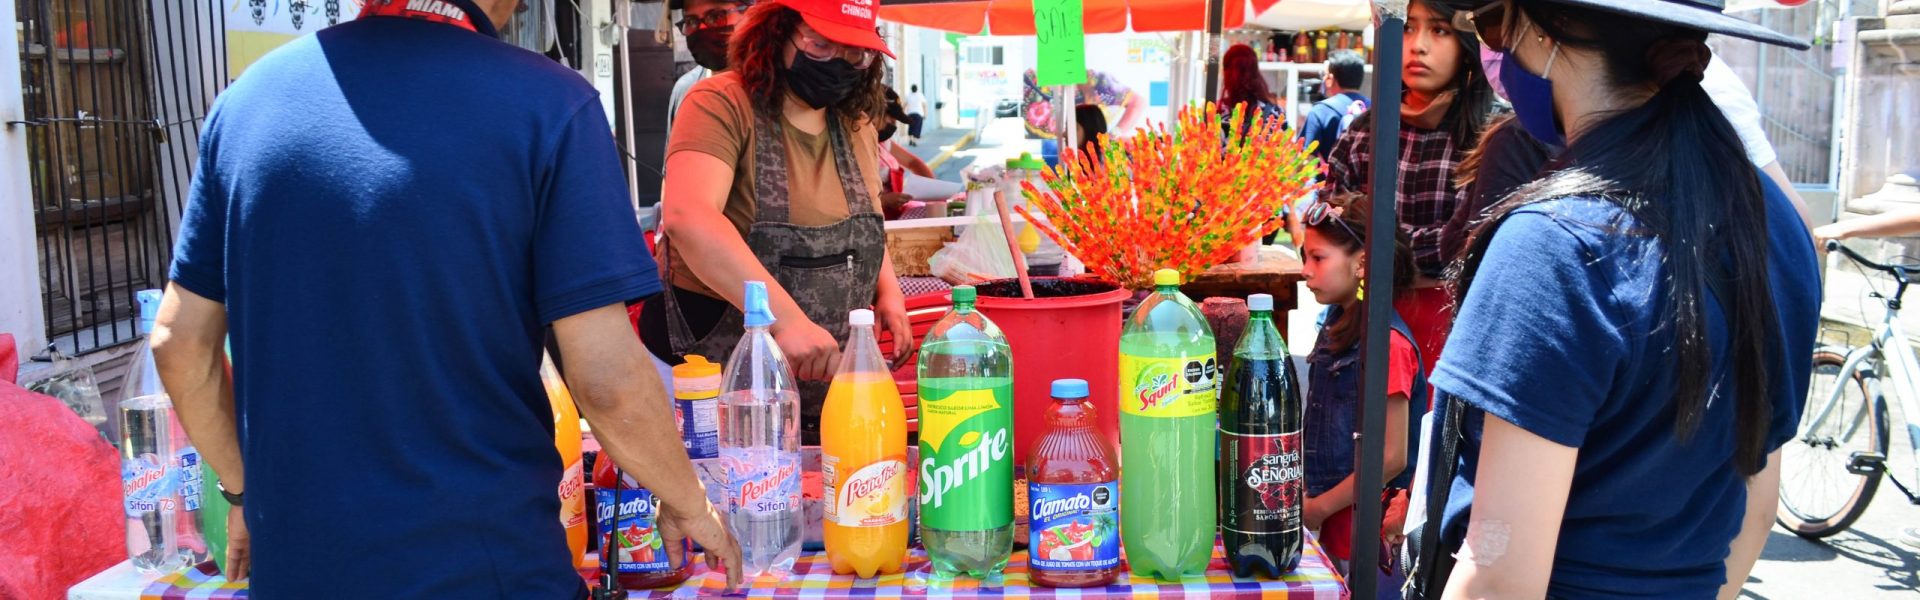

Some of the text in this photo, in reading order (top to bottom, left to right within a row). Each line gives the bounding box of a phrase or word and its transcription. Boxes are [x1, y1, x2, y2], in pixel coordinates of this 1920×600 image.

[406, 0, 465, 20] MIAMI
[920, 427, 1009, 509] Sprite
[1033, 493, 1090, 520] Clamato
